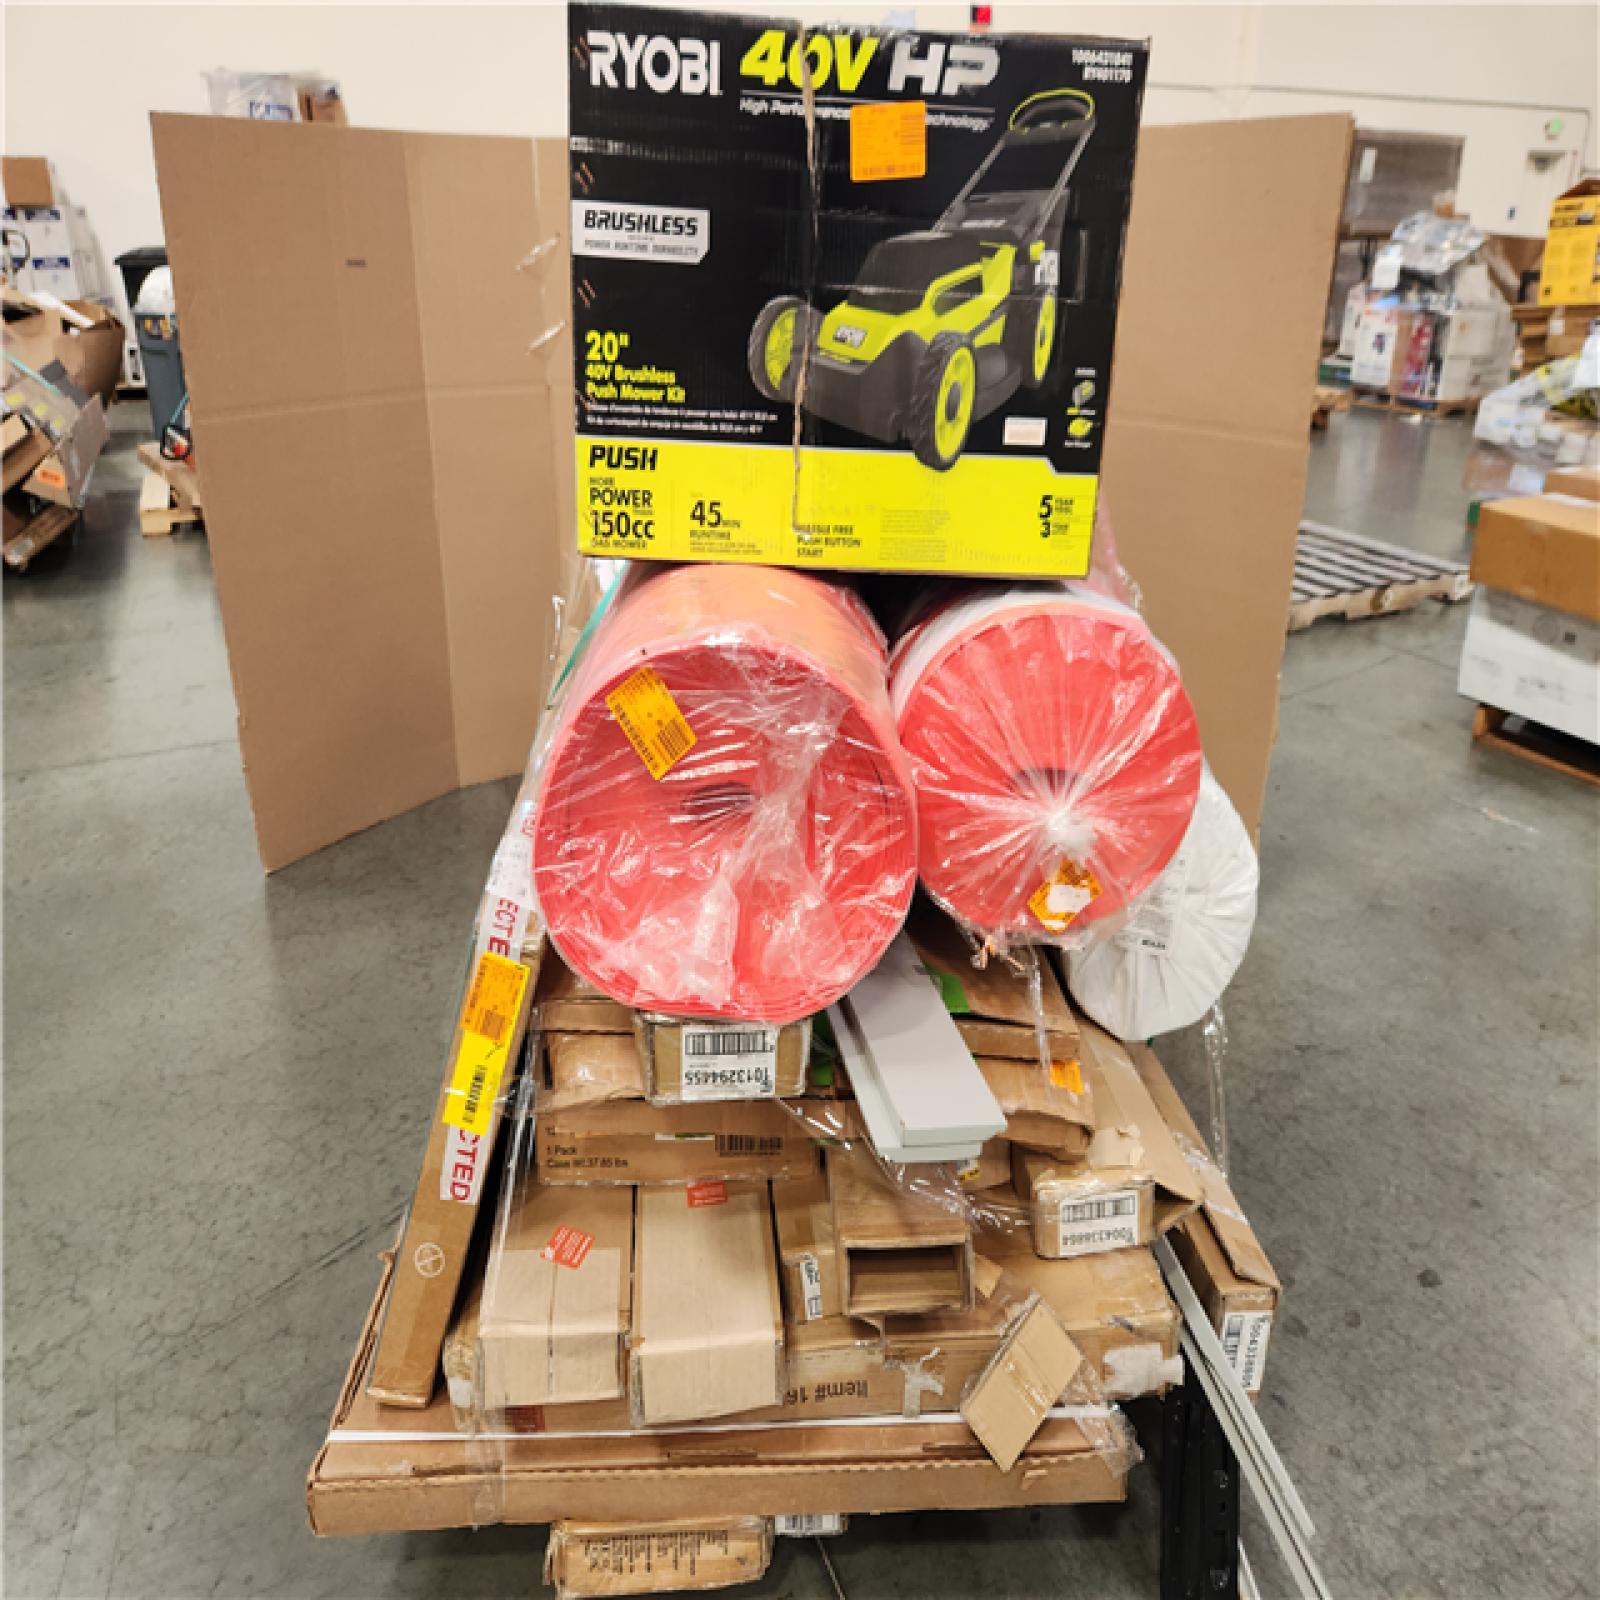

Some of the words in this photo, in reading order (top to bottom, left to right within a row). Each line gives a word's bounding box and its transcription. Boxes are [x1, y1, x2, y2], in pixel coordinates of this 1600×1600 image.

[586, 30, 720, 96] RYOBI
[740, 30, 880, 92] 40V
[888, 42, 999, 95] HP
[584, 209, 699, 236] BRUSHLESS
[585, 330, 630, 363] 20"
[588, 445, 658, 471] PUSH
[589, 487, 652, 508] POWER
[1039, 494, 1053, 519] 5
[592, 509, 655, 540] 150cc
[689, 500, 722, 528] 45
[1039, 519, 1051, 538] 3
